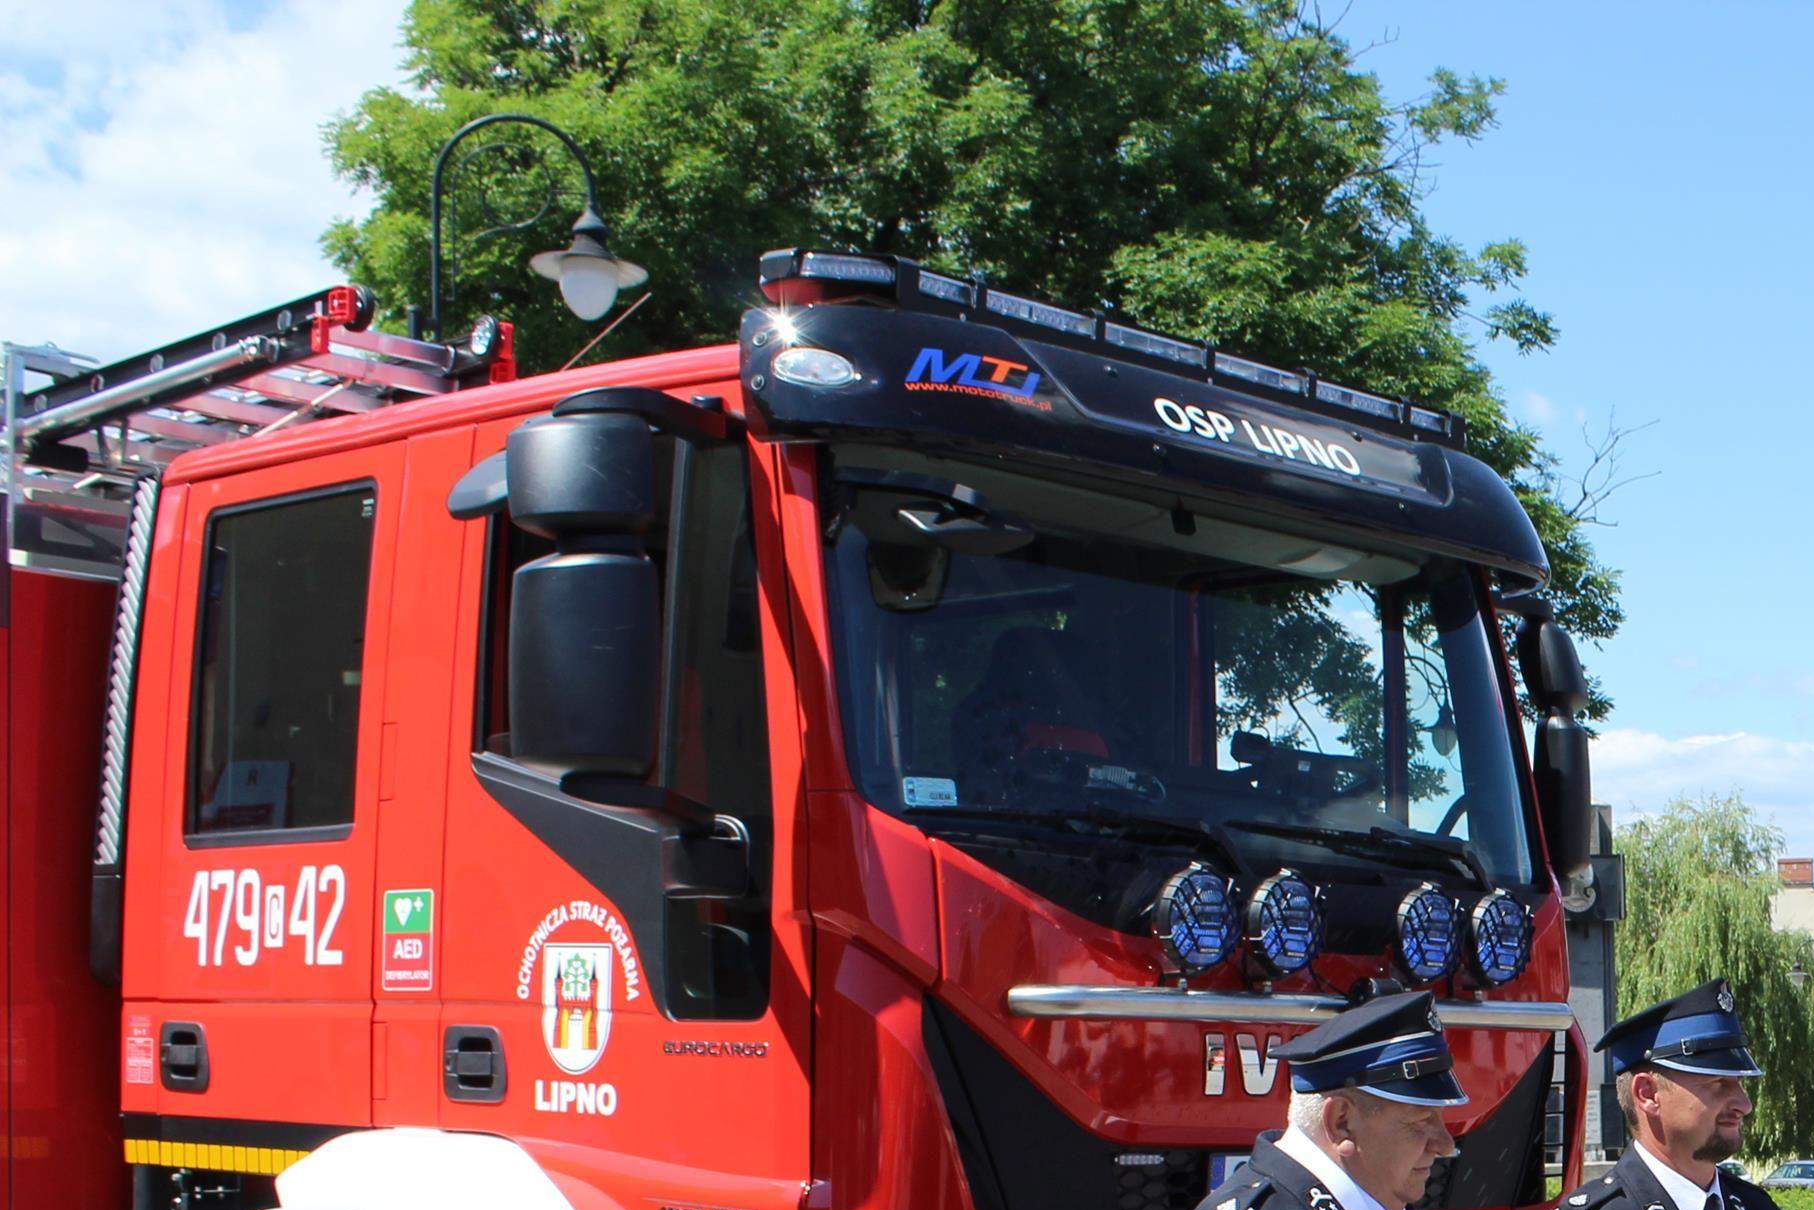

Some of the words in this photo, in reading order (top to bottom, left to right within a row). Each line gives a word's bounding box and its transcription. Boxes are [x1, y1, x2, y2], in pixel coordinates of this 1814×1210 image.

[904, 382, 1053, 412] www.mototruck.pl
[1153, 397, 1236, 443] OSP
[1241, 419, 1361, 477] LIPNO
[392, 938, 423, 960] AED
[516, 904, 569, 999] OCHOTNICZA
[663, 1040, 768, 1057] EUROCARGO
[534, 1079, 618, 1116] LIPNO
